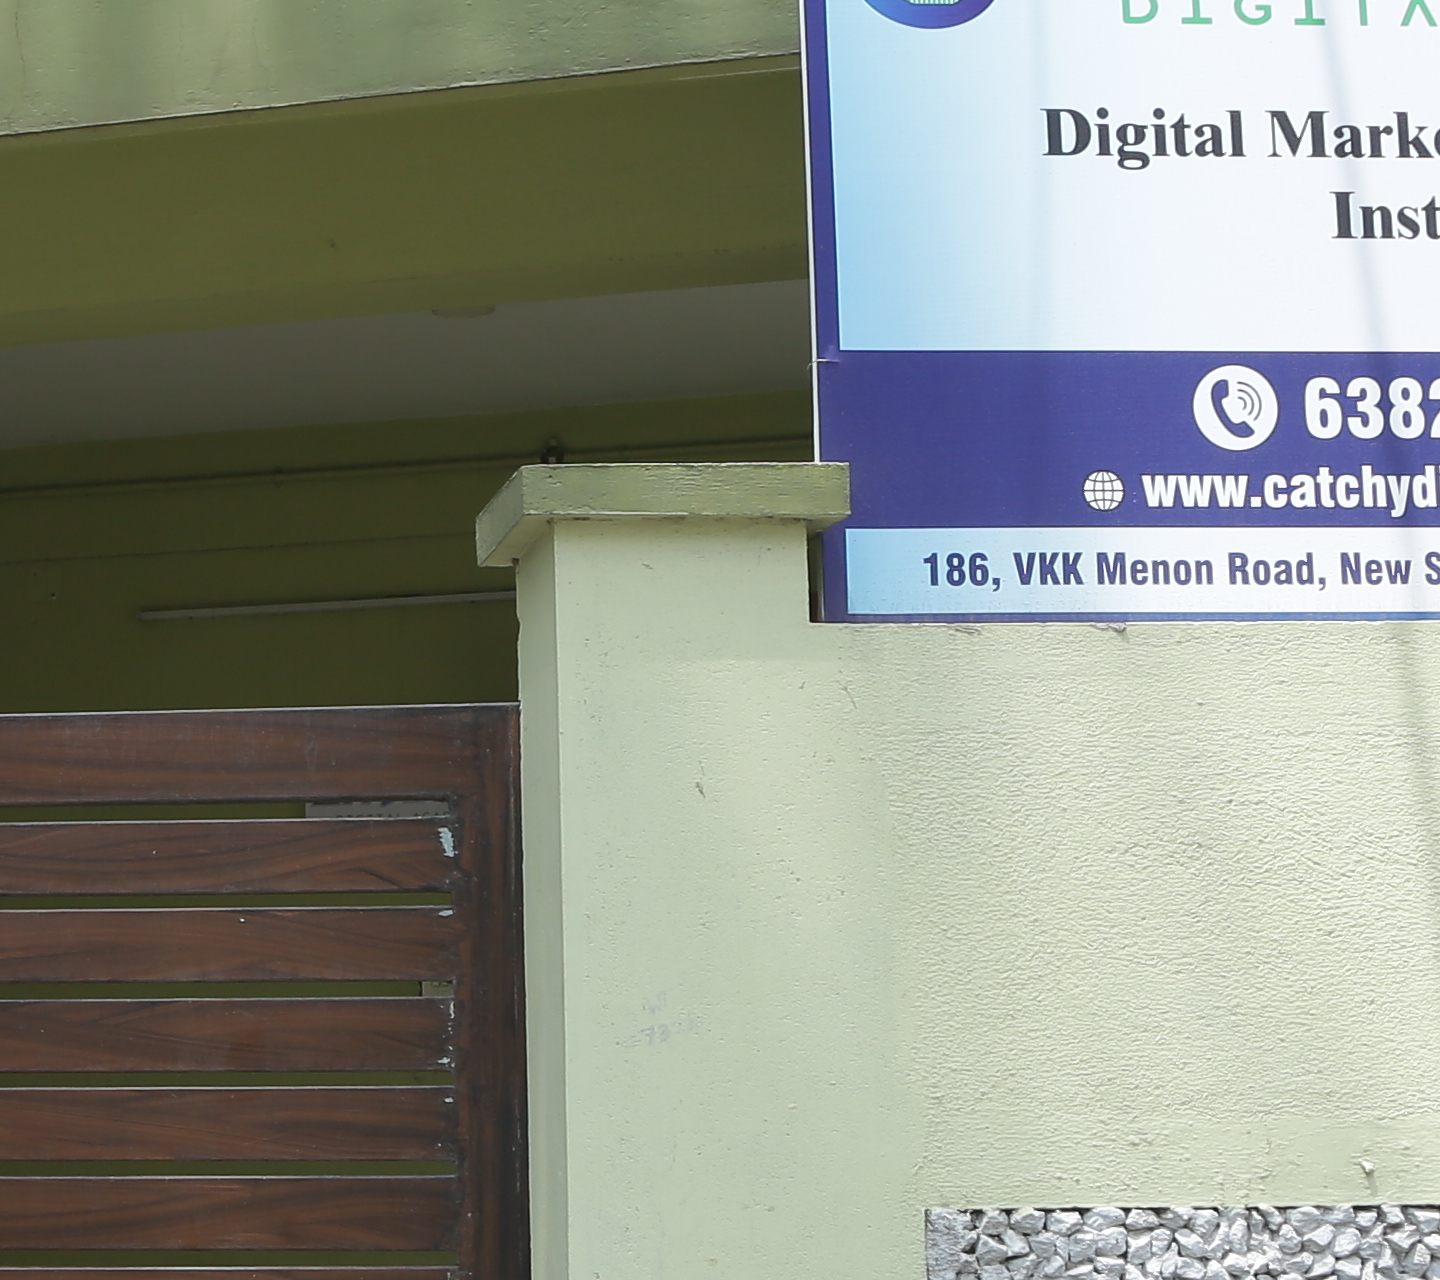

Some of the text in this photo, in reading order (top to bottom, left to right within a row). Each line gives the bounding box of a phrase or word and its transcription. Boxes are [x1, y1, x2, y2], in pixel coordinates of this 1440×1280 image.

[1042, 107, 1244, 170] Digital
[923, 552, 1002, 592] 186,
[1013, 552, 1084, 586] VKK
[1096, 552, 1213, 586] Menon
[1228, 552, 1326, 592] Road,
[1340, 552, 1411, 585] New
